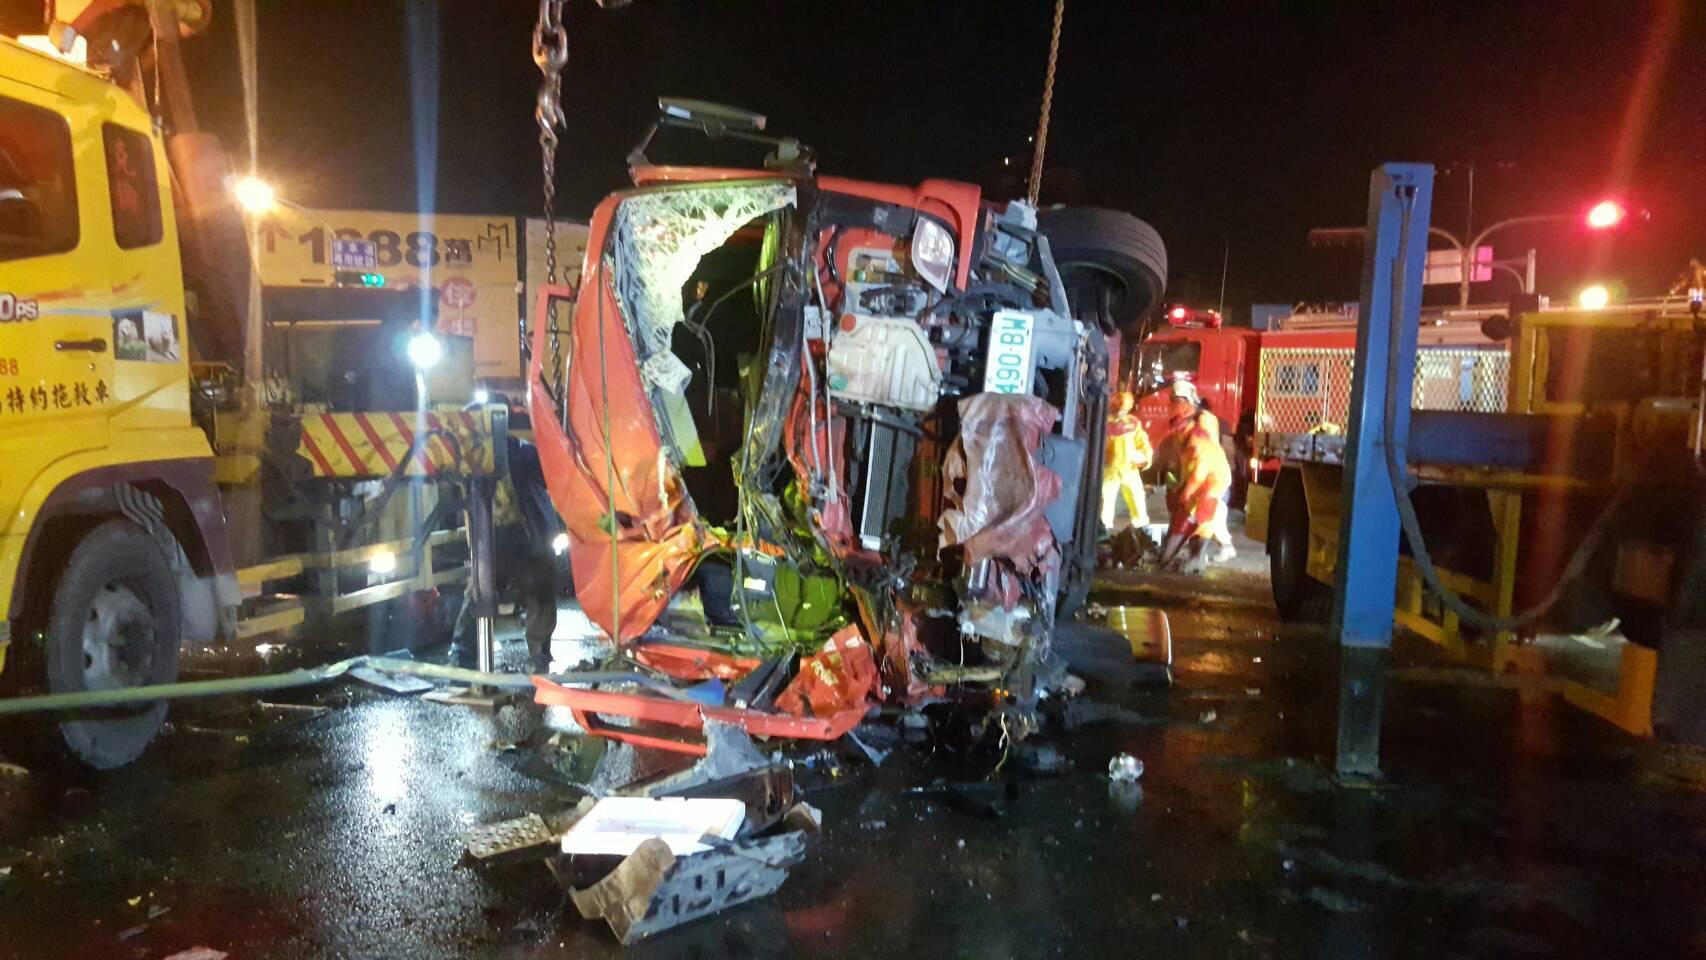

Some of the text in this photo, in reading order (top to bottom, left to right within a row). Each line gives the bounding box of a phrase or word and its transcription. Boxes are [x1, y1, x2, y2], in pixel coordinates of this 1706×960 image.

[0, 379, 109, 415] 特約拖救車
